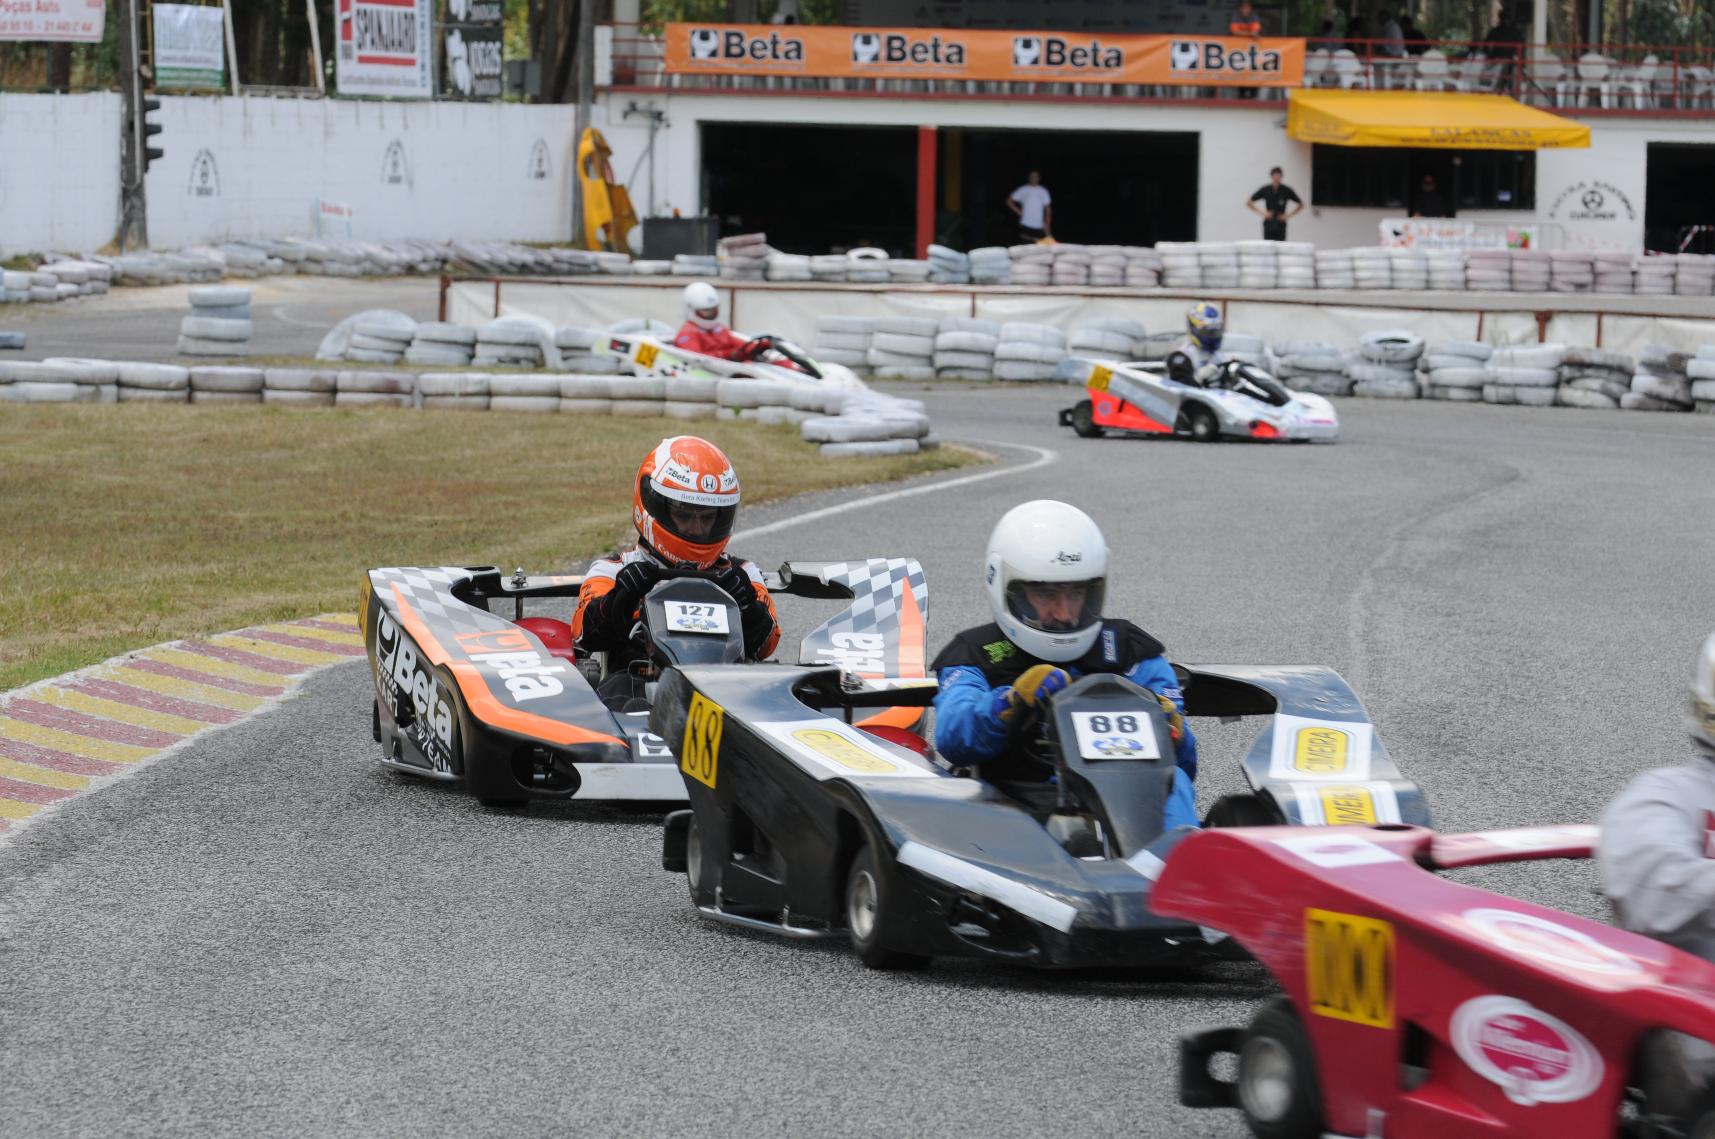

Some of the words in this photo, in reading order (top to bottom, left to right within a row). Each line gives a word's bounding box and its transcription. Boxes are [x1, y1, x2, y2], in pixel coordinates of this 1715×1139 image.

[356, 9, 416, 53] SPANJAARD
[724, 32, 803, 60] Beta
[886, 36, 964, 63] Beta
[1045, 40, 1122, 68] Beta
[1204, 43, 1280, 71] Beta
[671, 470, 690, 484] Beta
[675, 605, 716, 617] 127
[394, 633, 452, 750] Beta
[1089, 715, 1138, 733] 88
[687, 702, 718, 780] 88
